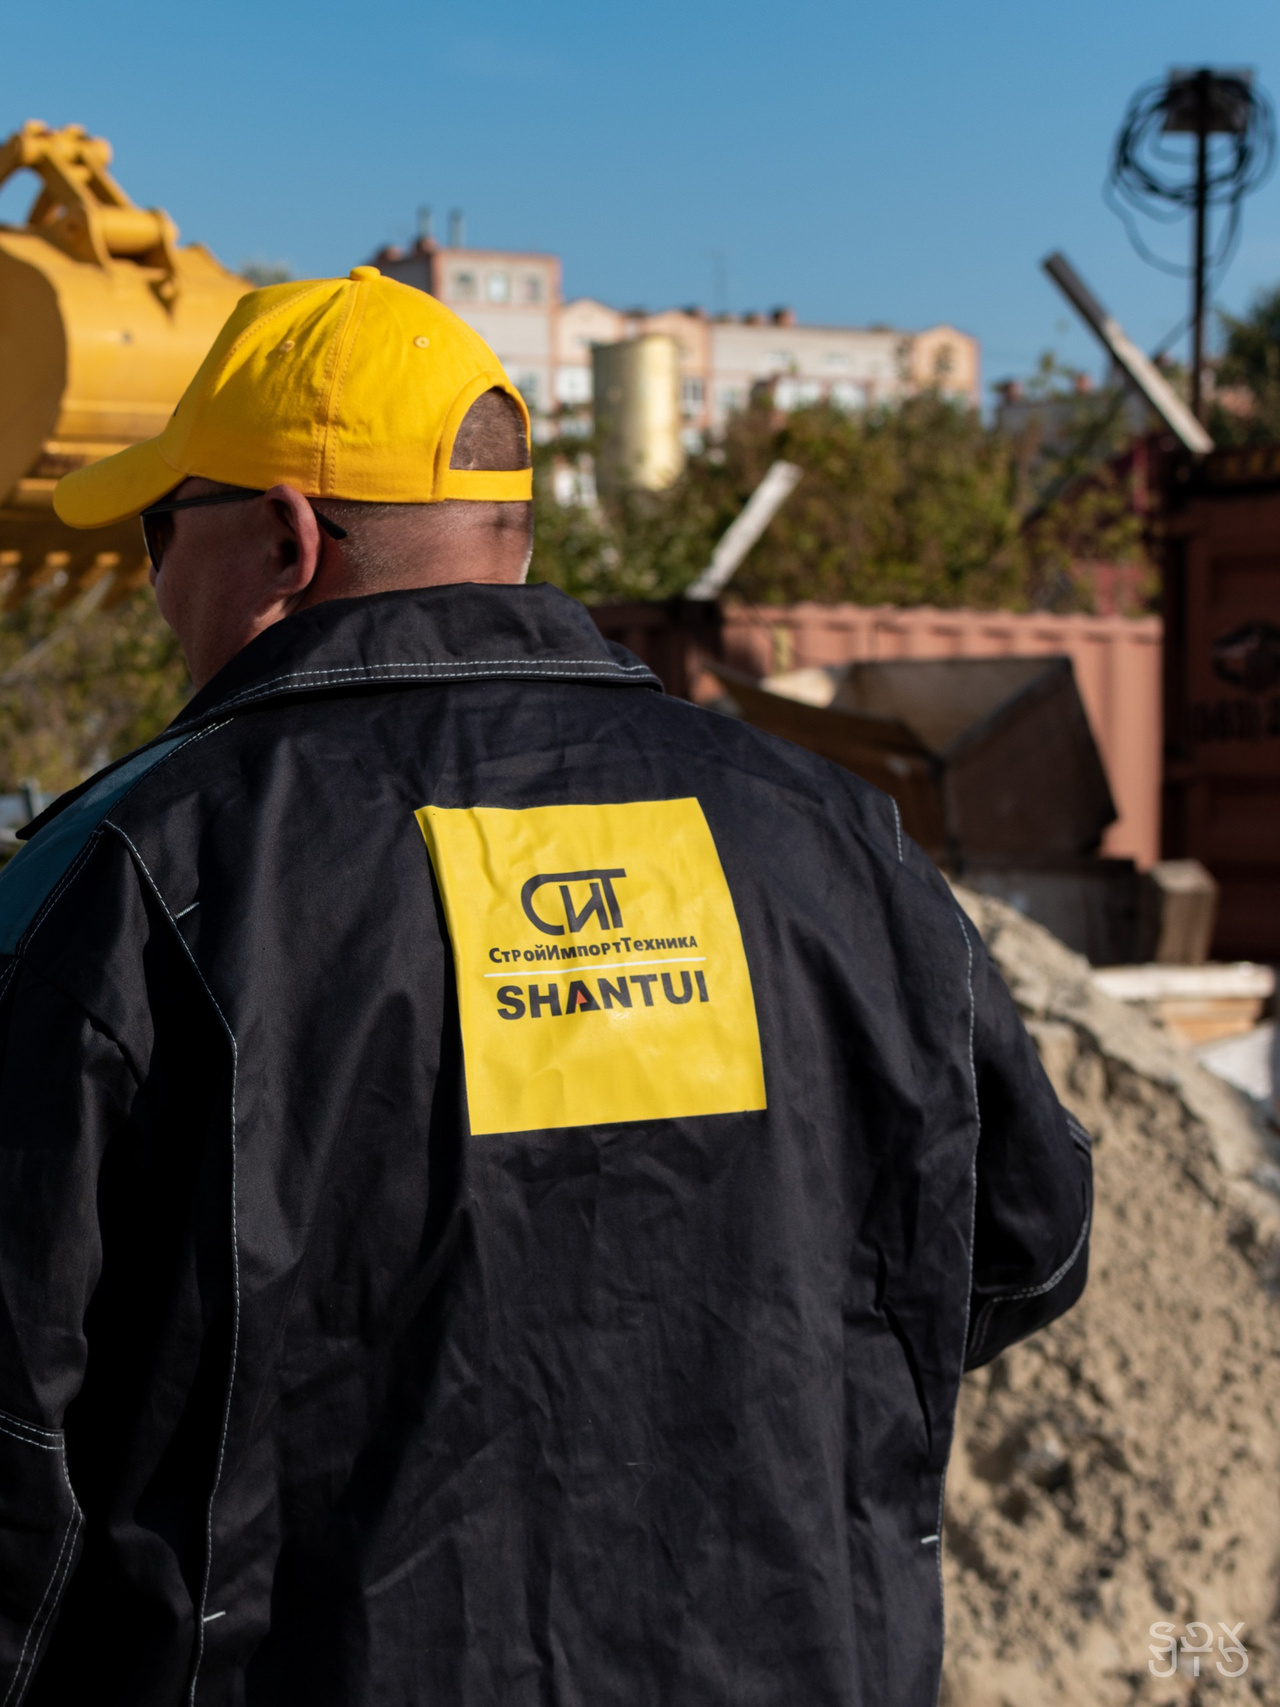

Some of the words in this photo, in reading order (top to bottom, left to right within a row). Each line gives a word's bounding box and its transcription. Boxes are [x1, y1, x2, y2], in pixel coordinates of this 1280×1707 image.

[520, 868, 627, 935] СИТ
[489, 936, 698, 964] СтройИмпортТехника
[496, 970, 710, 1020] SHANTUI
